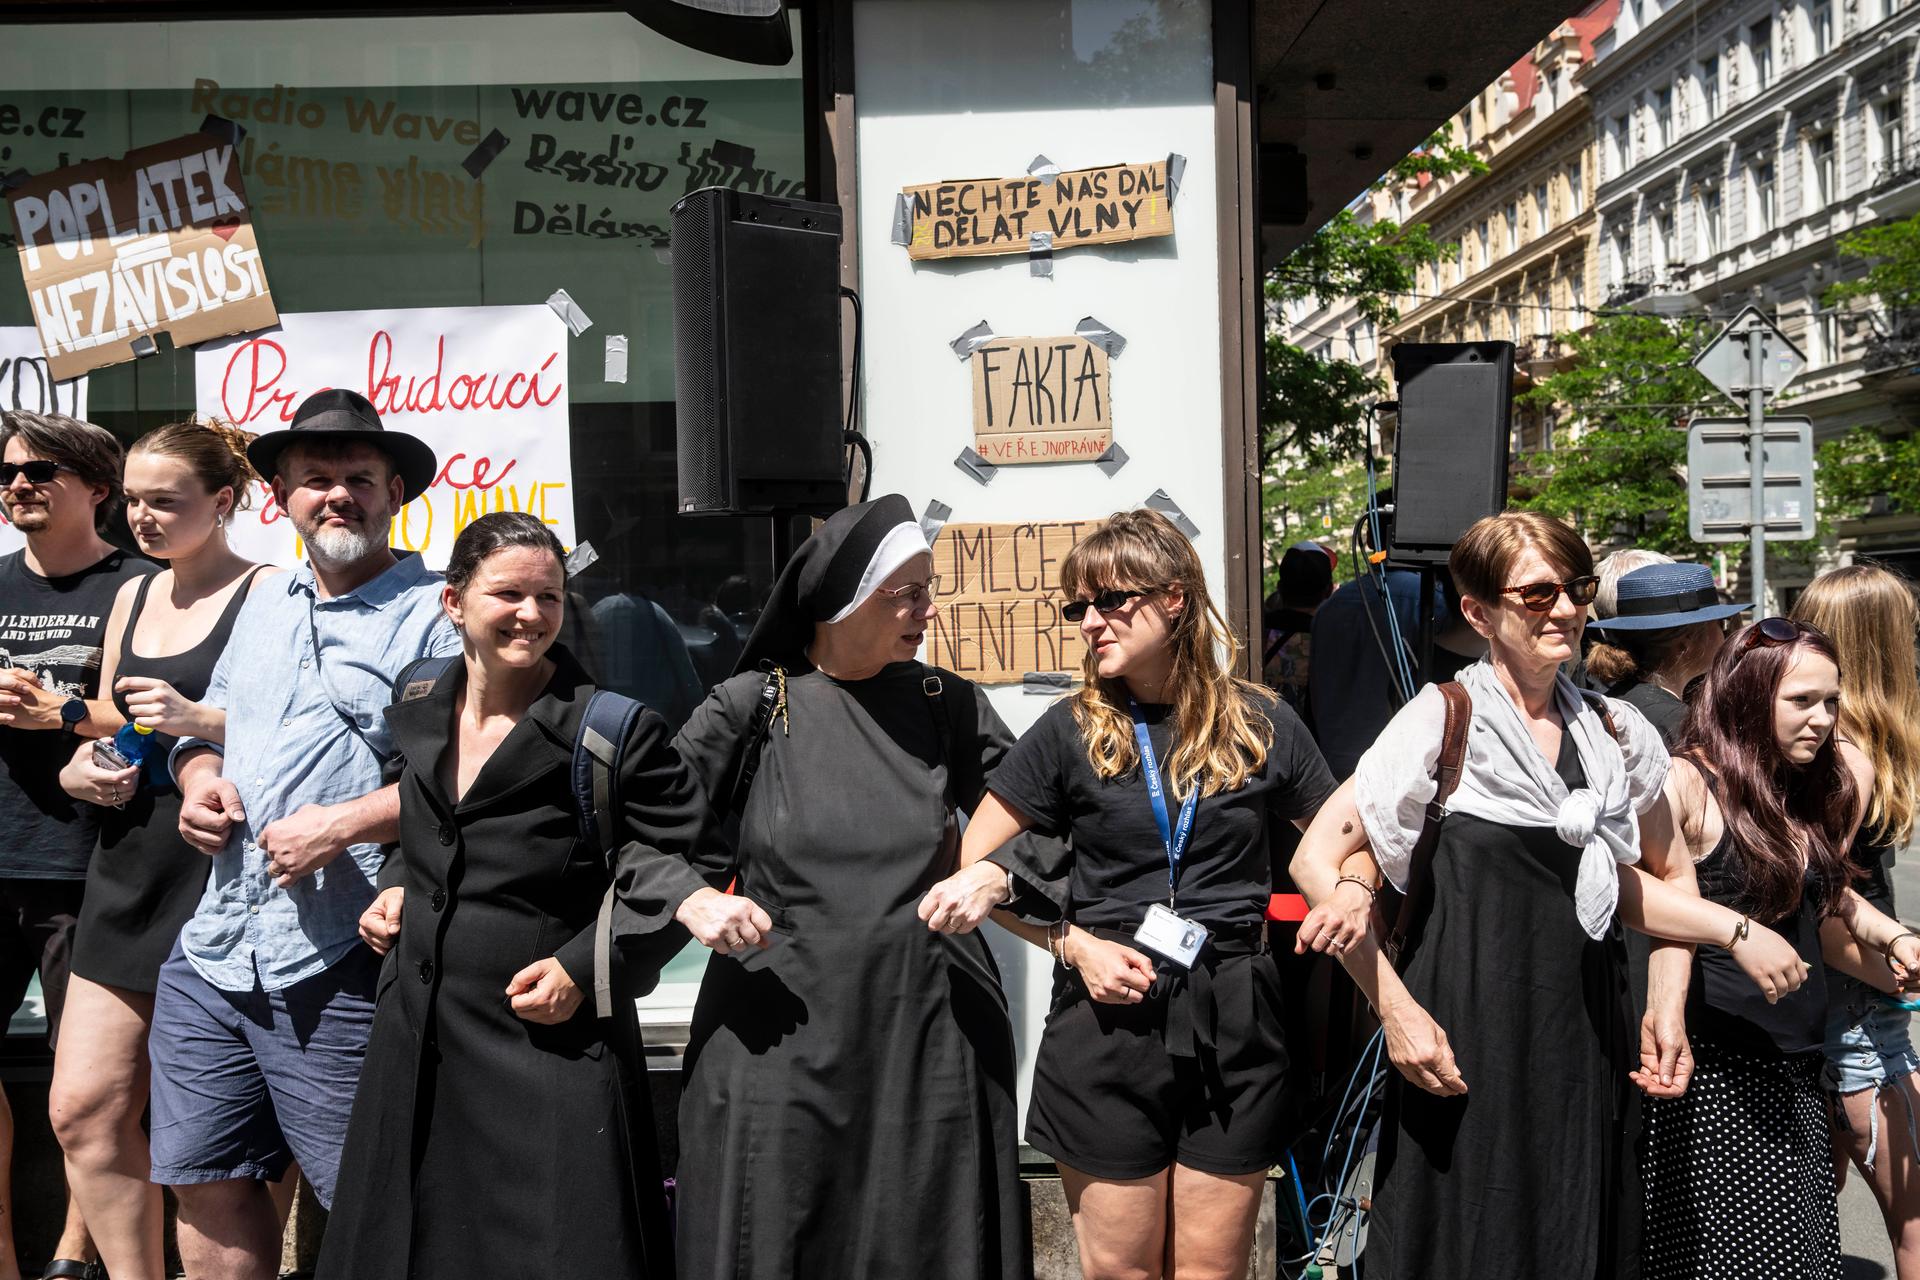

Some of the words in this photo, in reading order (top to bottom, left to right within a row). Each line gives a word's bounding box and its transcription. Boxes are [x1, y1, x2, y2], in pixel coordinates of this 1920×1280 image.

[191, 78, 326, 128] Radio
[344, 96, 480, 145] Wave
[511, 88, 709, 128] wave.cz
[14, 144, 245, 271] POPLATEK
[913, 181, 1042, 220] NECHTE
[1056, 171, 1108, 206] NÁS
[1119, 165, 1165, 196] DÁL
[934, 210, 1029, 249] DĚLAT
[32, 244, 265, 357] NEZÁVISLOST
[222, 338, 334, 425] Pr
[368, 330, 563, 416] budoucí
[978, 344, 1101, 428] FAKTA
[0, 630, 26, 641] AND
[28, 630, 46, 642] THE
[46, 629, 72, 640] WIND
[8, 614, 100, 629] LENDERMAN
[934, 600, 1020, 672] NENÍ
